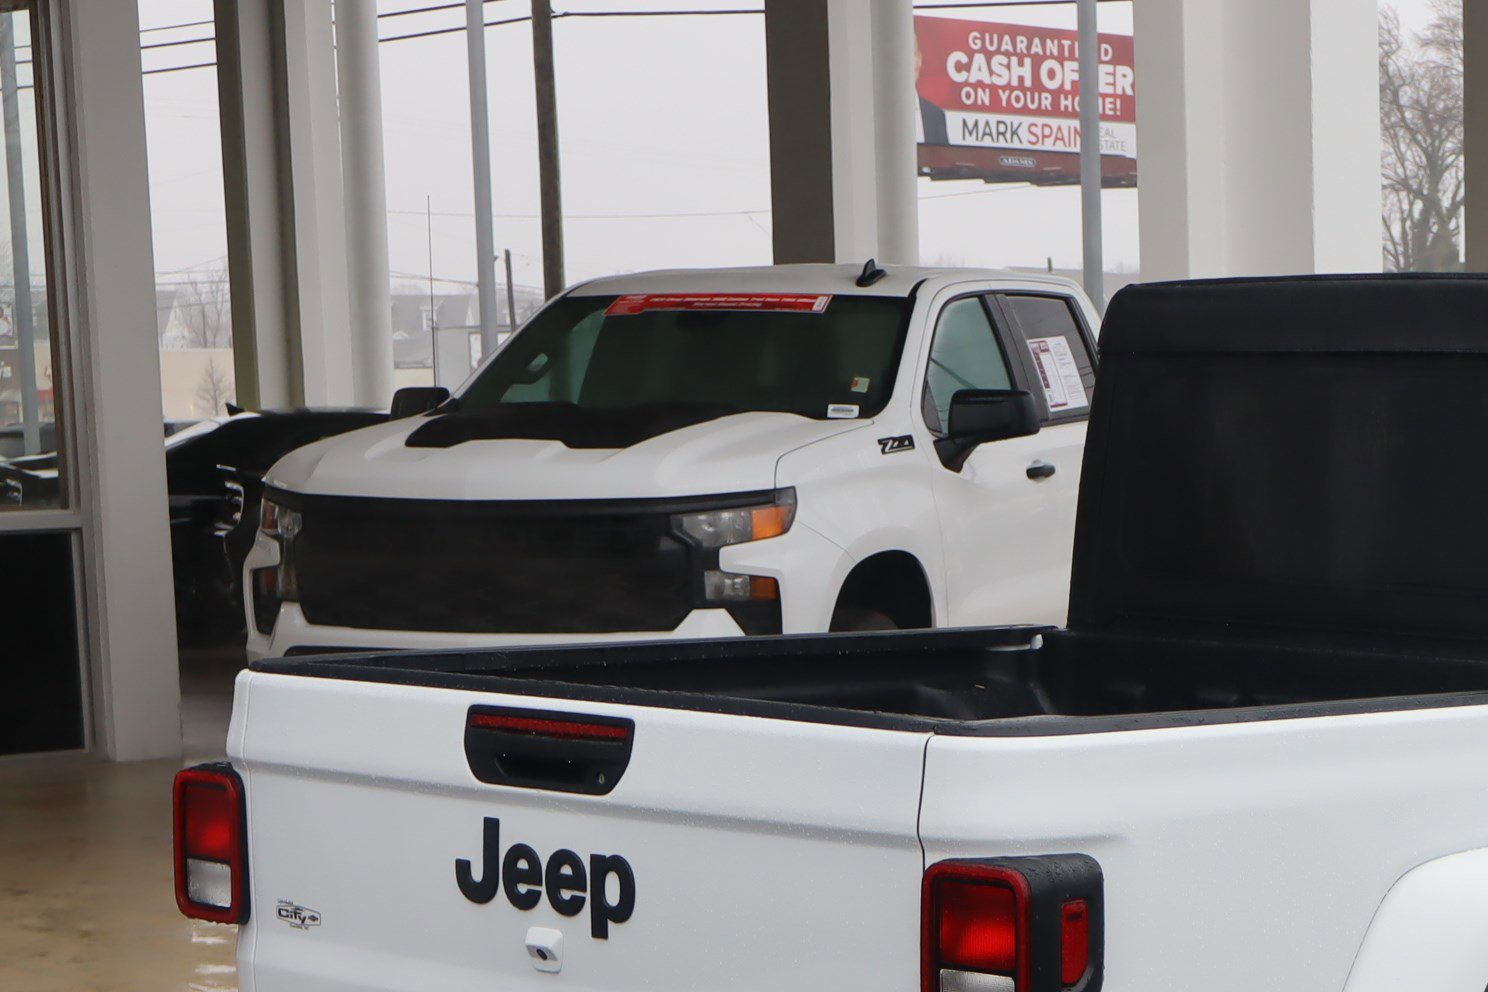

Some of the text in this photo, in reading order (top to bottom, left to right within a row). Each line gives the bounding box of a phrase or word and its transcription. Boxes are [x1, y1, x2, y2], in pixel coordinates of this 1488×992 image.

[967, 31, 1113, 62] GUARANTD
[946, 50, 1134, 96] CASH OFER
[961, 86, 1121, 116] ON YOUR HE!
[962, 117, 1023, 145] MARK
[1099, 126, 1117, 140] EAL
[1099, 138, 1127, 153] STATE
[455, 816, 636, 941] Jeep
